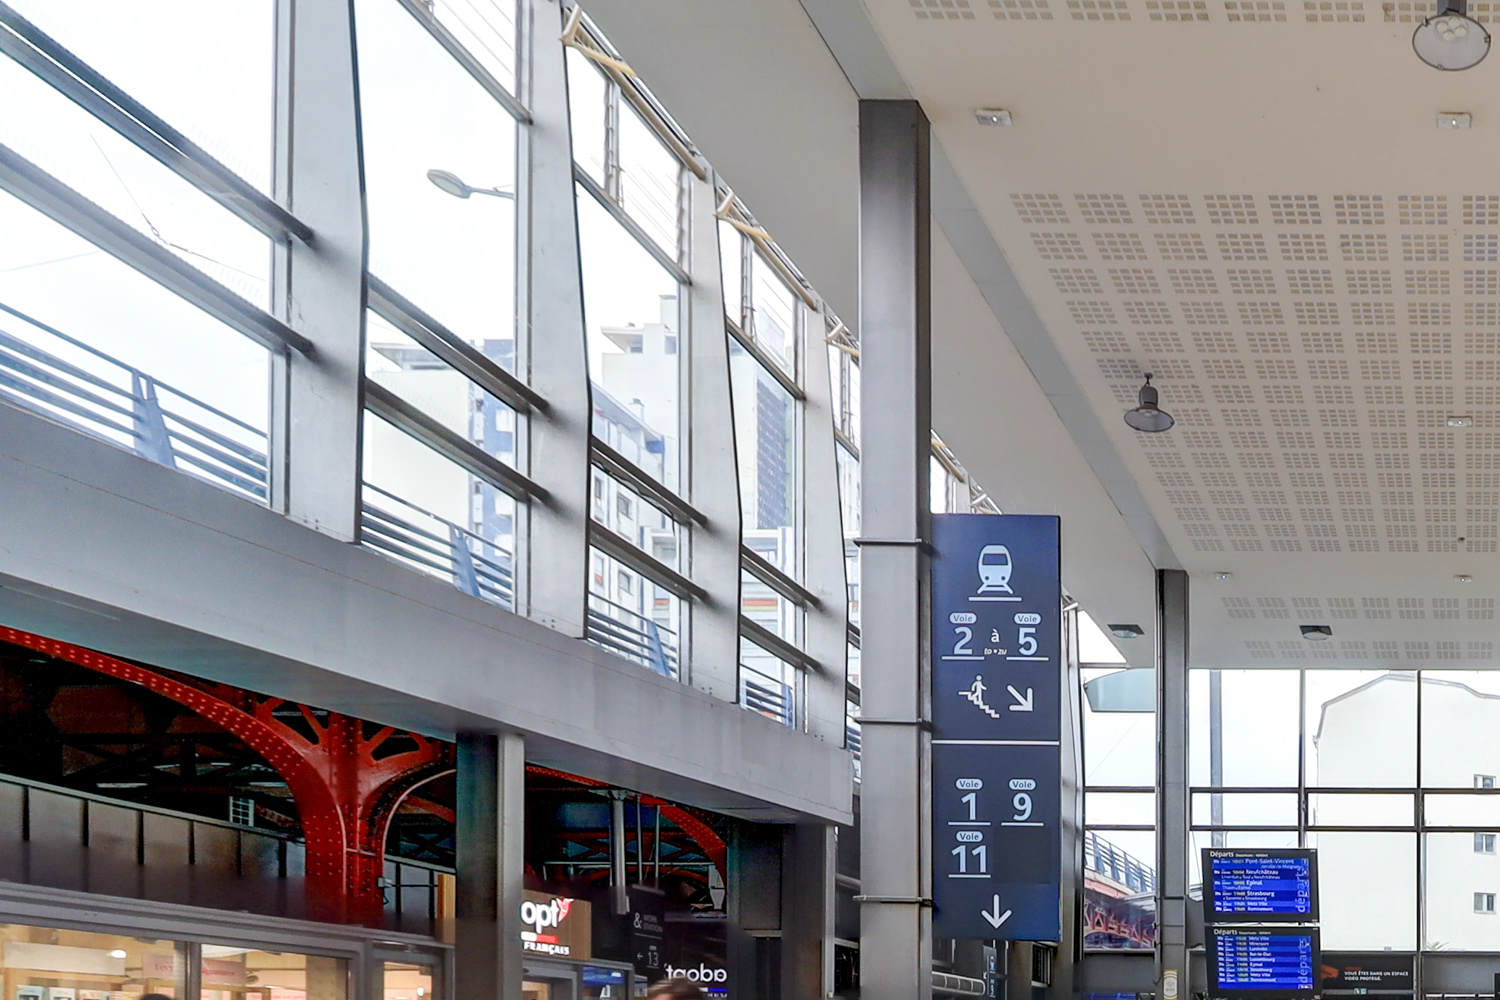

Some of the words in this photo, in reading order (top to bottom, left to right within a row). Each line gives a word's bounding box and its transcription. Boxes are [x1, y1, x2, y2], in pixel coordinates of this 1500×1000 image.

[953, 614, 973, 622] Voie
[1018, 615, 1037, 623] Voie
[954, 626, 973, 655] 2
[991, 628, 1000, 643] à
[1018, 627, 1038, 656] 5
[961, 792, 976, 820] 1
[1013, 792, 1032, 821] 9
[951, 845, 986, 873] 11
[1210, 850, 1234, 858] Départs
[1213, 928, 1238, 936] Départs
[523, 941, 570, 955] FRANÇAIS
[648, 951, 659, 966] 13
